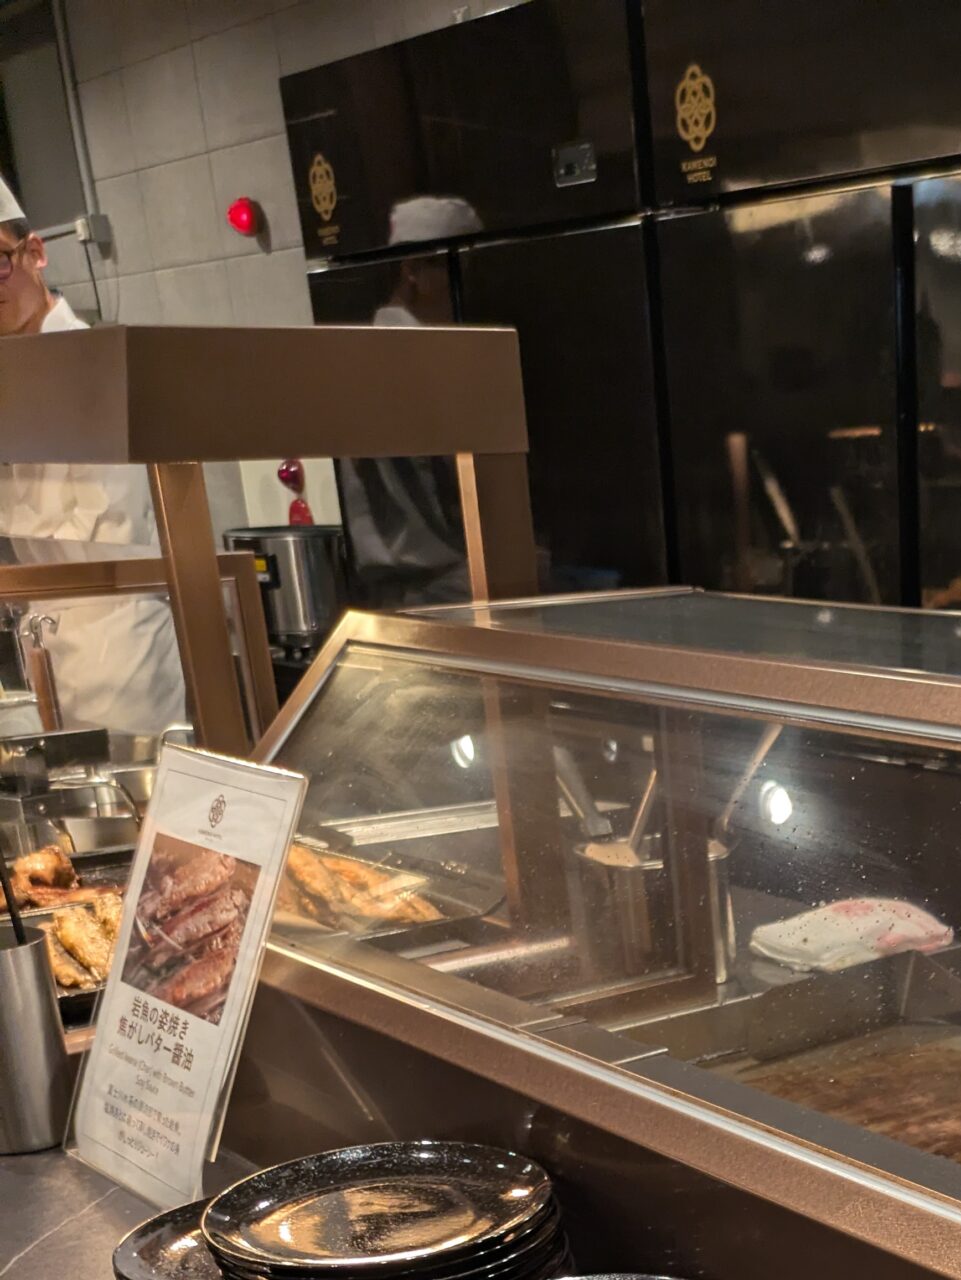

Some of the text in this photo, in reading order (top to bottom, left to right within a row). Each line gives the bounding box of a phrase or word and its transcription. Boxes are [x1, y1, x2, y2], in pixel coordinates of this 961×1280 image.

[131, 995, 190, 1041] 岩魚の姿焼き
